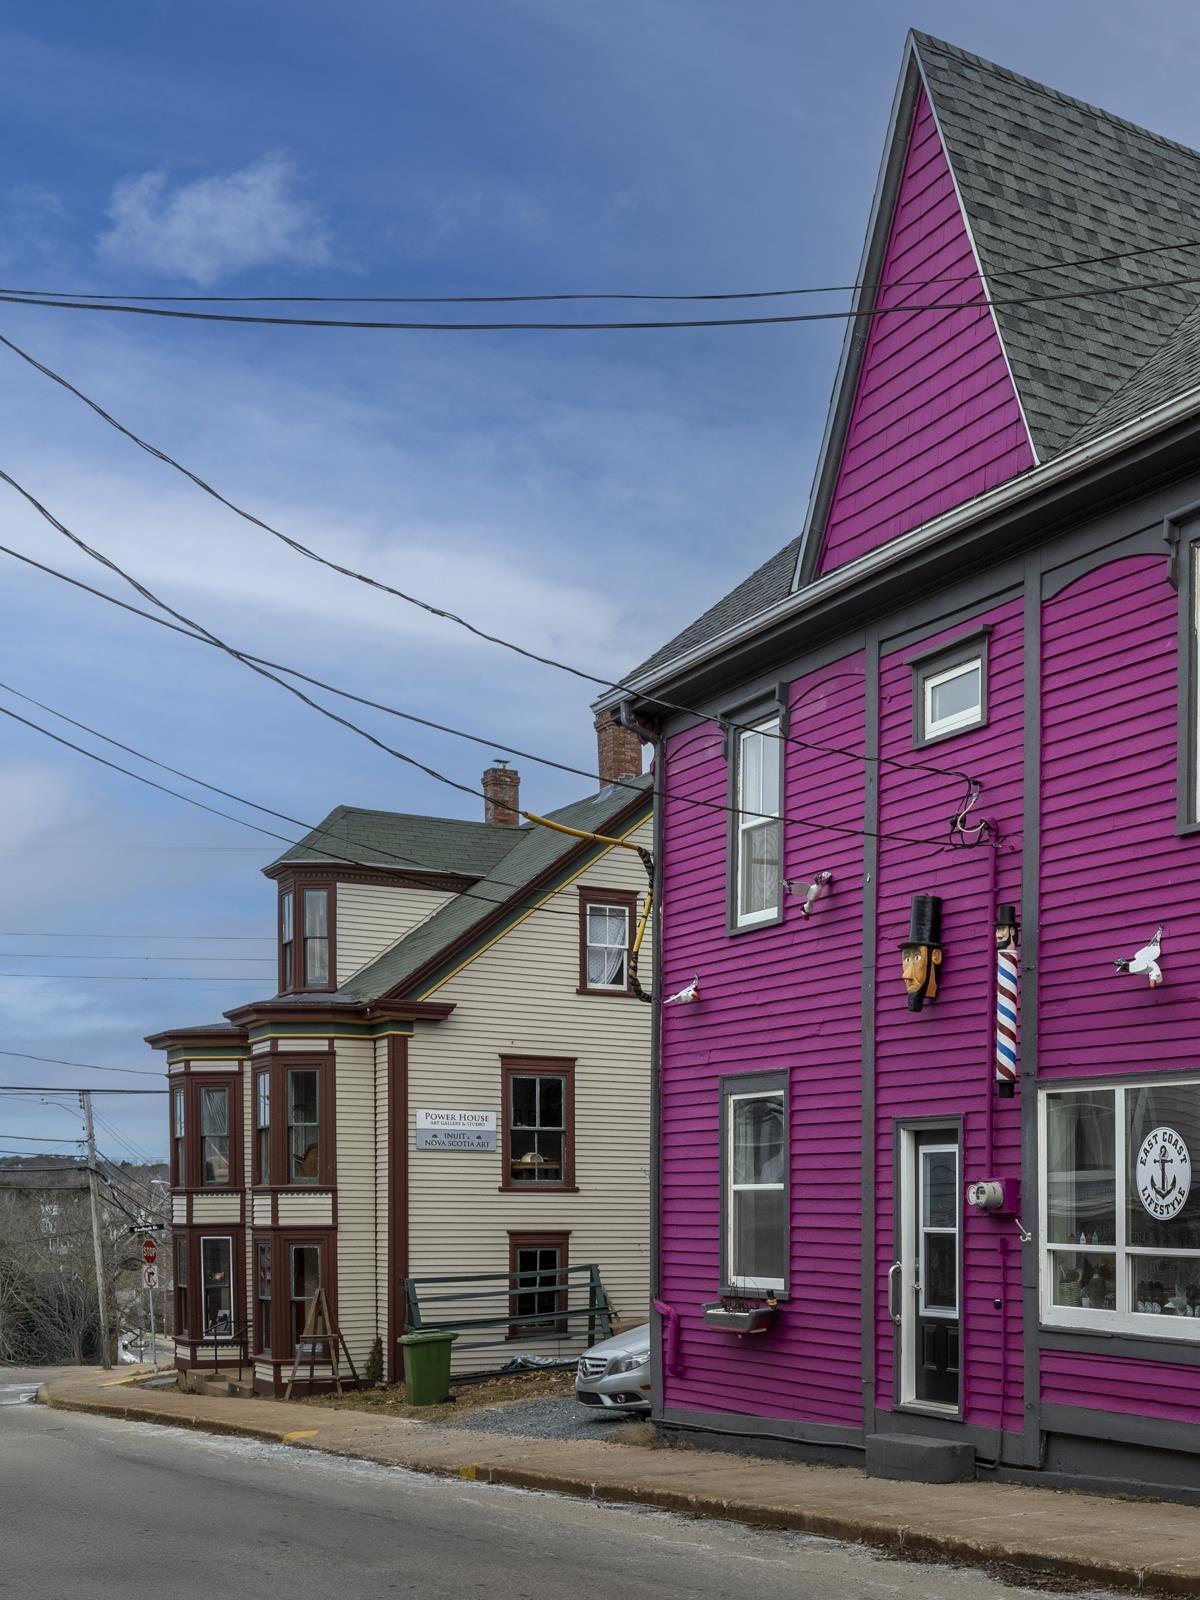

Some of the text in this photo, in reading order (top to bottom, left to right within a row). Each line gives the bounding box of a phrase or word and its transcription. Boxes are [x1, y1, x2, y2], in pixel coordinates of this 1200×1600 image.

[425, 1112, 489, 1122] POWER HOUSE
[1139, 1131, 1188, 1167] EAST COAST
[1141, 1185, 1186, 1216] LIFESTYLE
[143, 1246, 156, 1257] STOP
